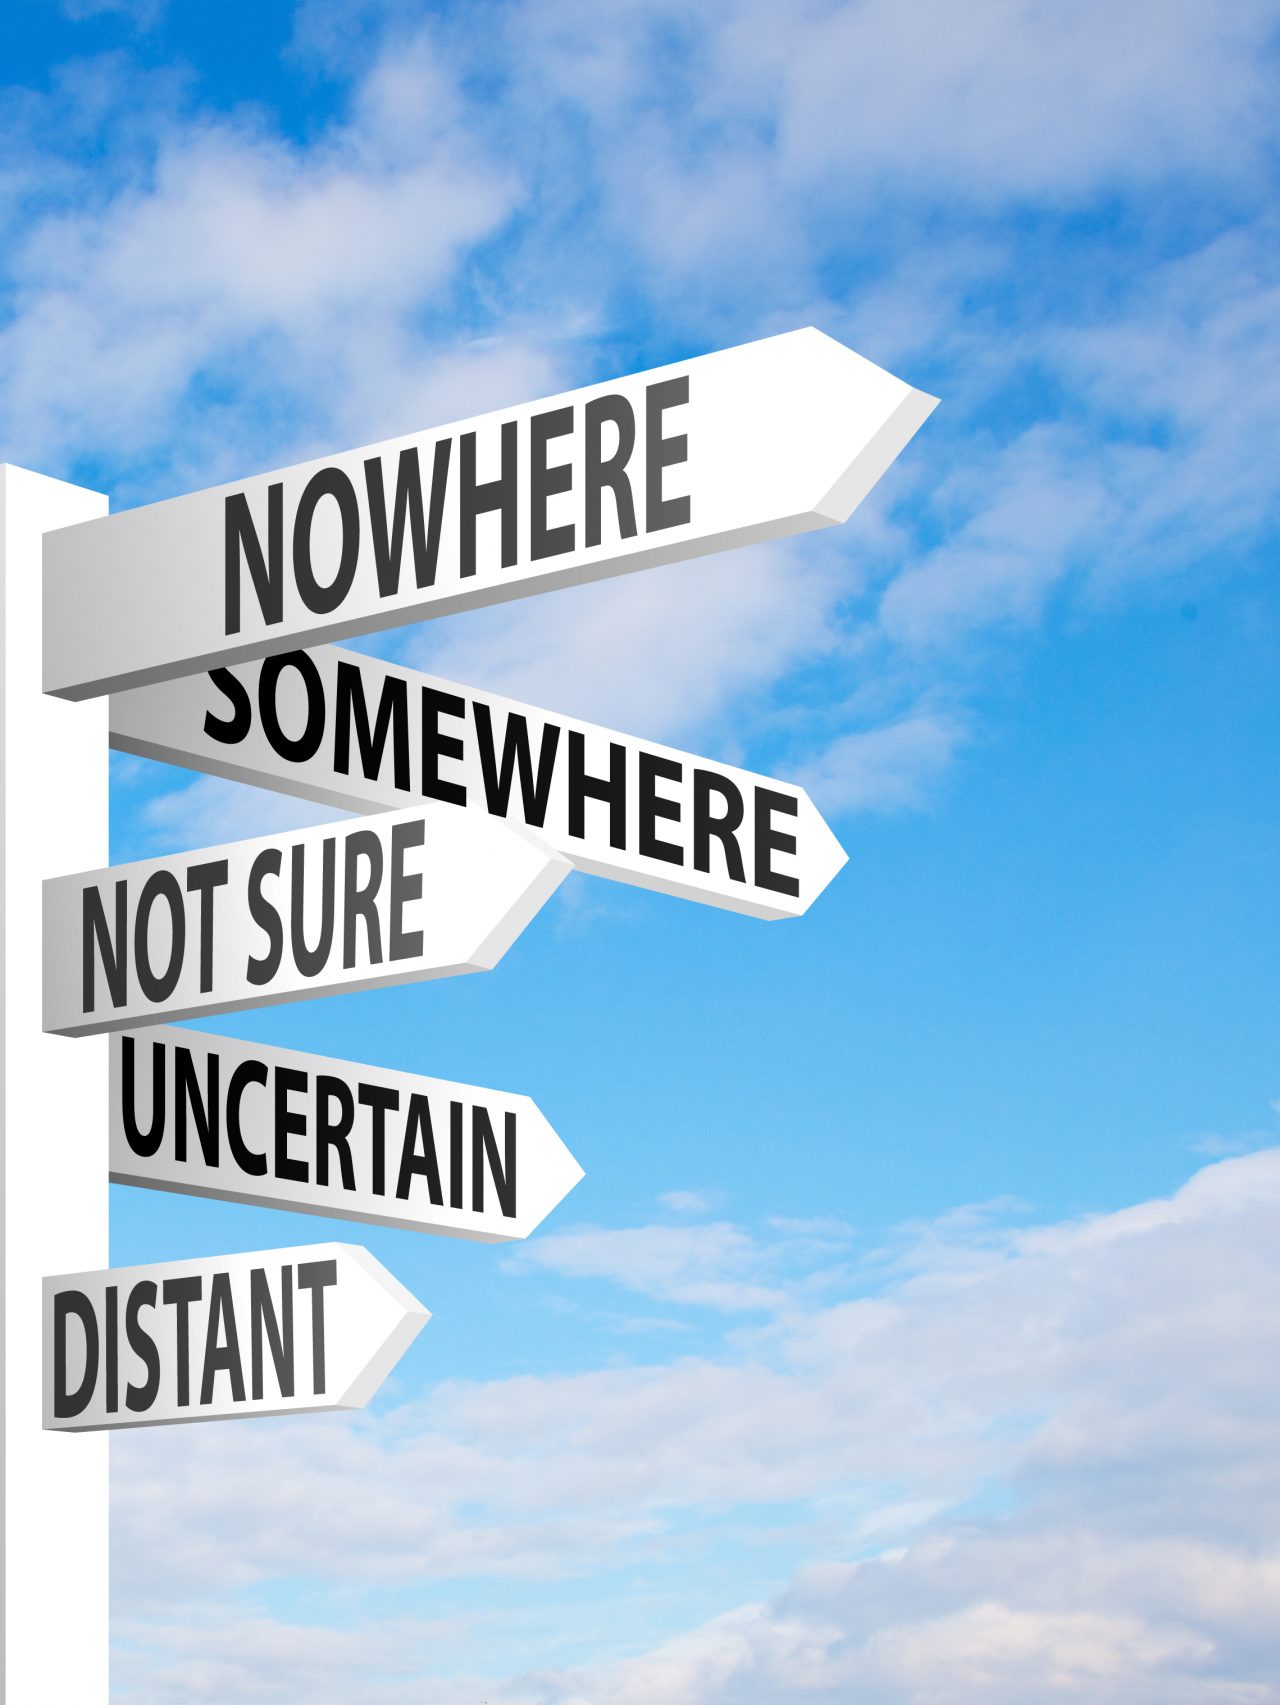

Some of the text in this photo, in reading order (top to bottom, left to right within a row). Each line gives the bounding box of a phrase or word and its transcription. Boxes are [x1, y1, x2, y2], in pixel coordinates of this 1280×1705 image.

[224, 375, 691, 636] NOWHERE
[204, 649, 800, 898] SOMEWHERE
[82, 819, 425, 1014] NOT SURE
[121, 1036, 518, 1219] UNCERTAIN
[53, 1259, 338, 1419] DISTANT
